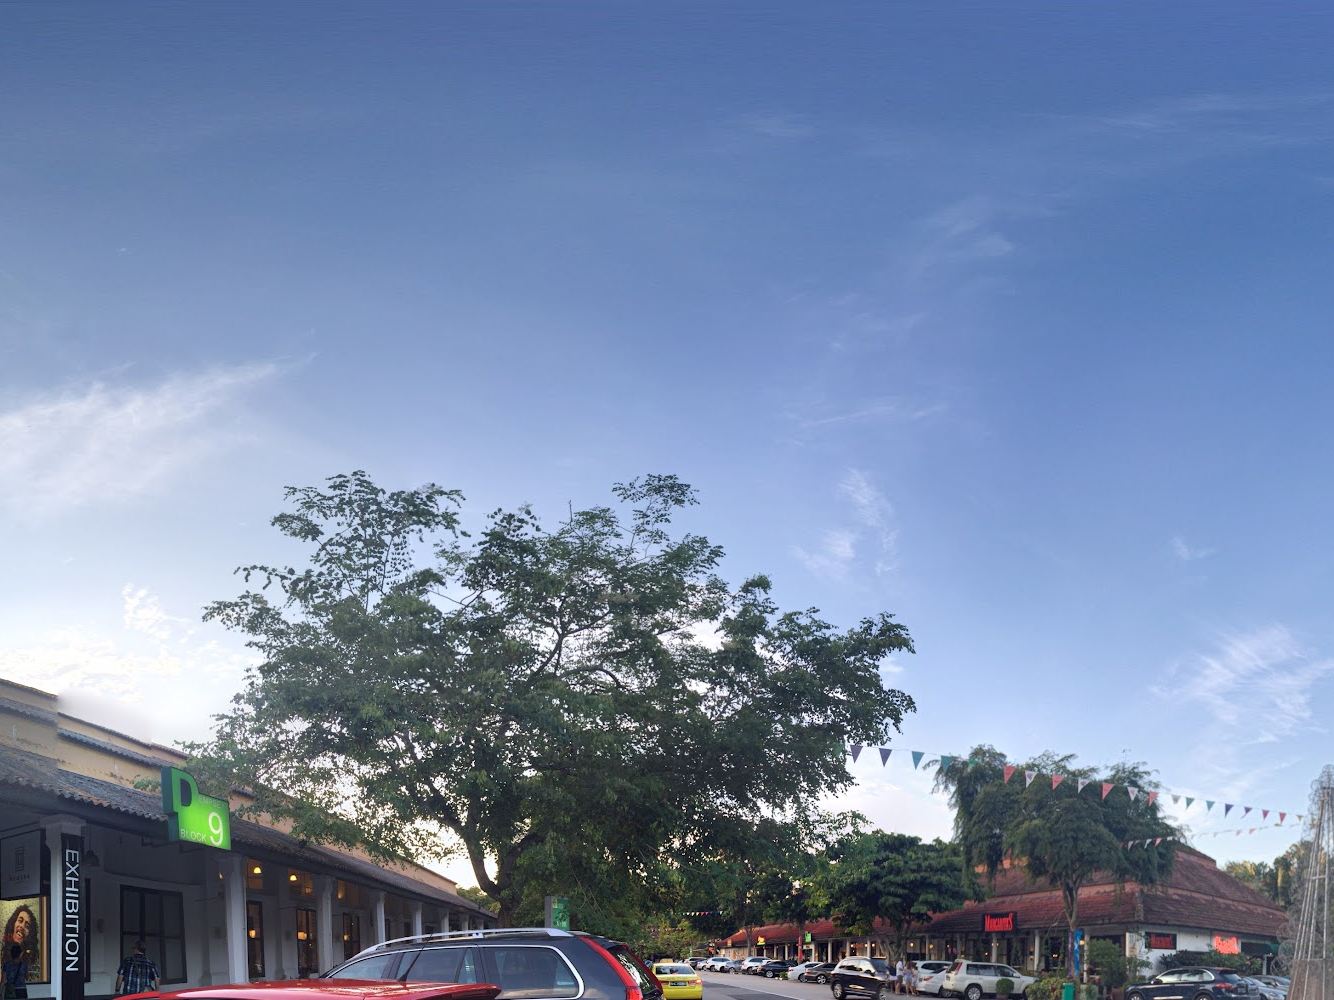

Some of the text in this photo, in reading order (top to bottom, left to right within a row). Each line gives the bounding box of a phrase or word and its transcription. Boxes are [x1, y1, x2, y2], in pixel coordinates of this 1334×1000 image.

[180, 811, 223, 847] BLOCK 9
[65, 849, 79, 972] EXHIBITION
